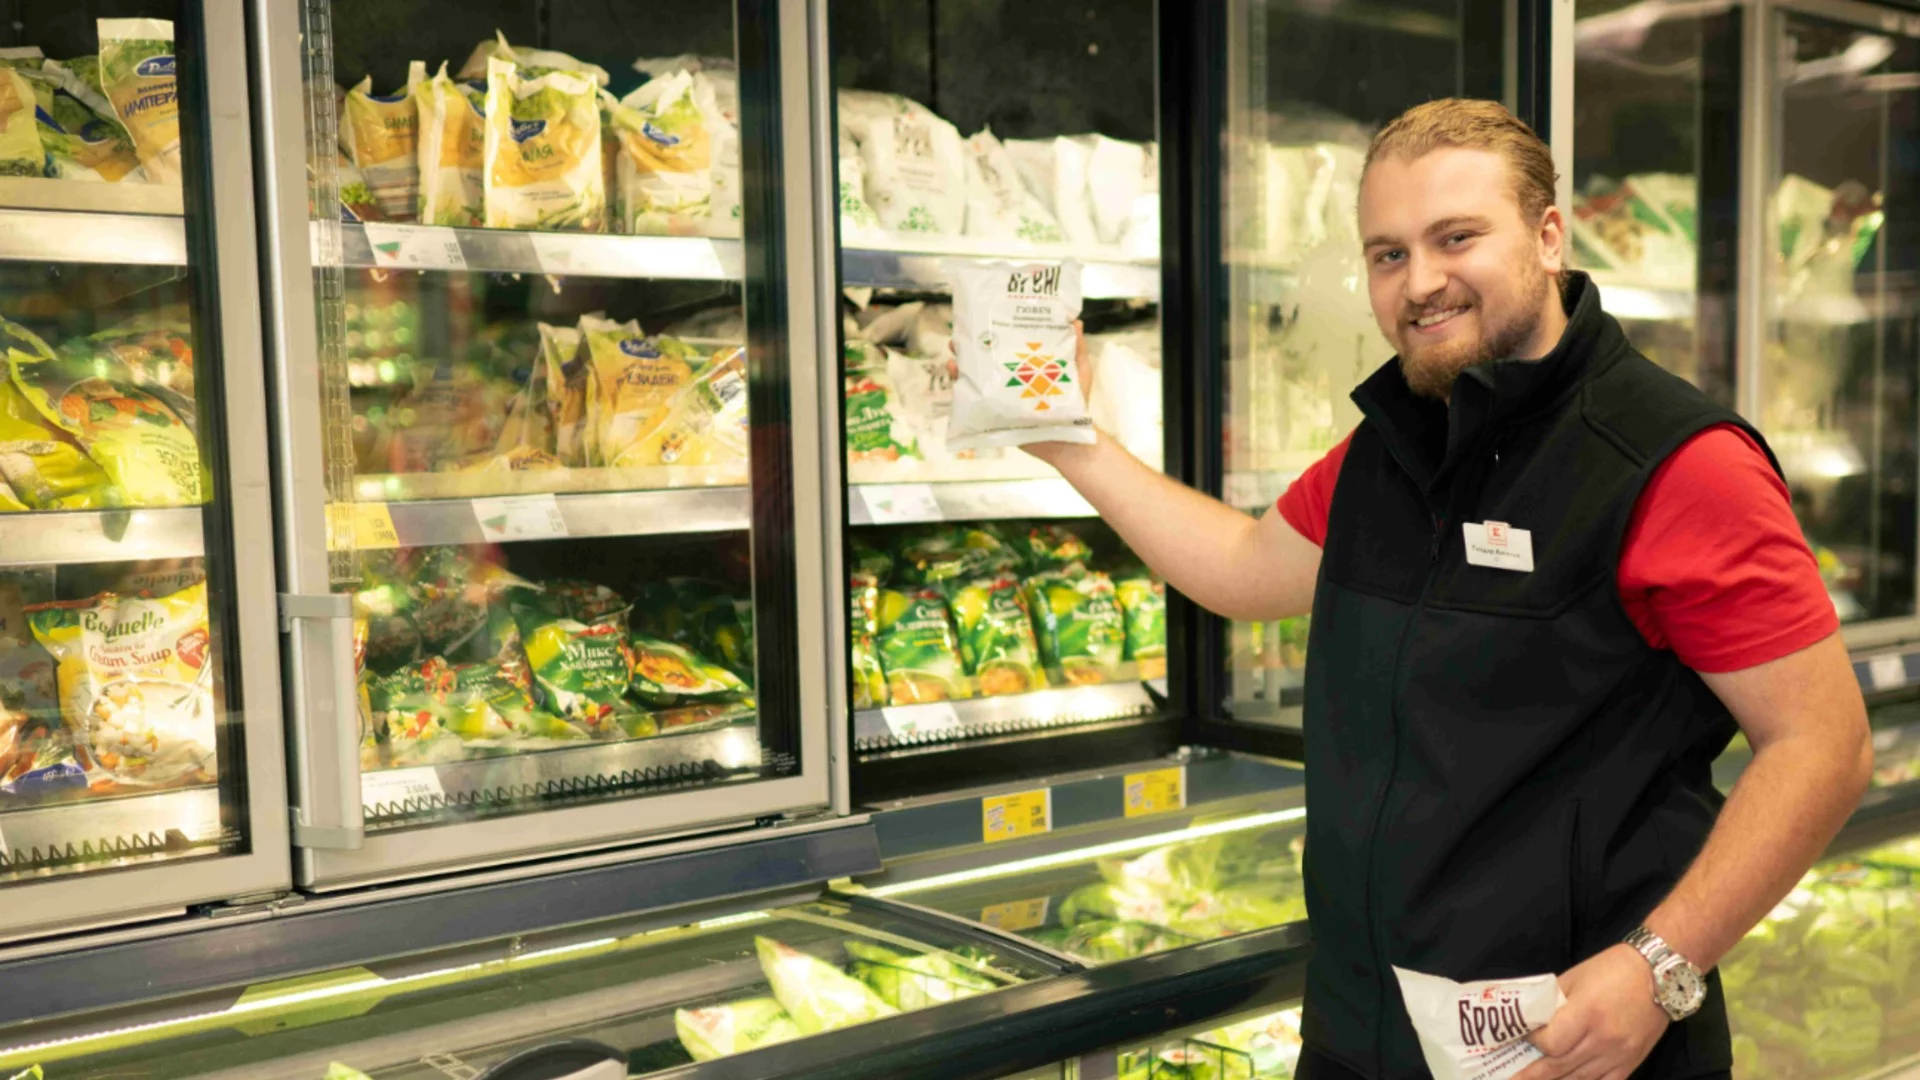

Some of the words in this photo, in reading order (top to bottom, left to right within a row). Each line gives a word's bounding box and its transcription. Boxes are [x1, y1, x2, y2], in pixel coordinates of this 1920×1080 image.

[90, 645, 127, 667] Cream
[130, 647, 171, 665] Soup
[566, 641, 613, 662] Микс
